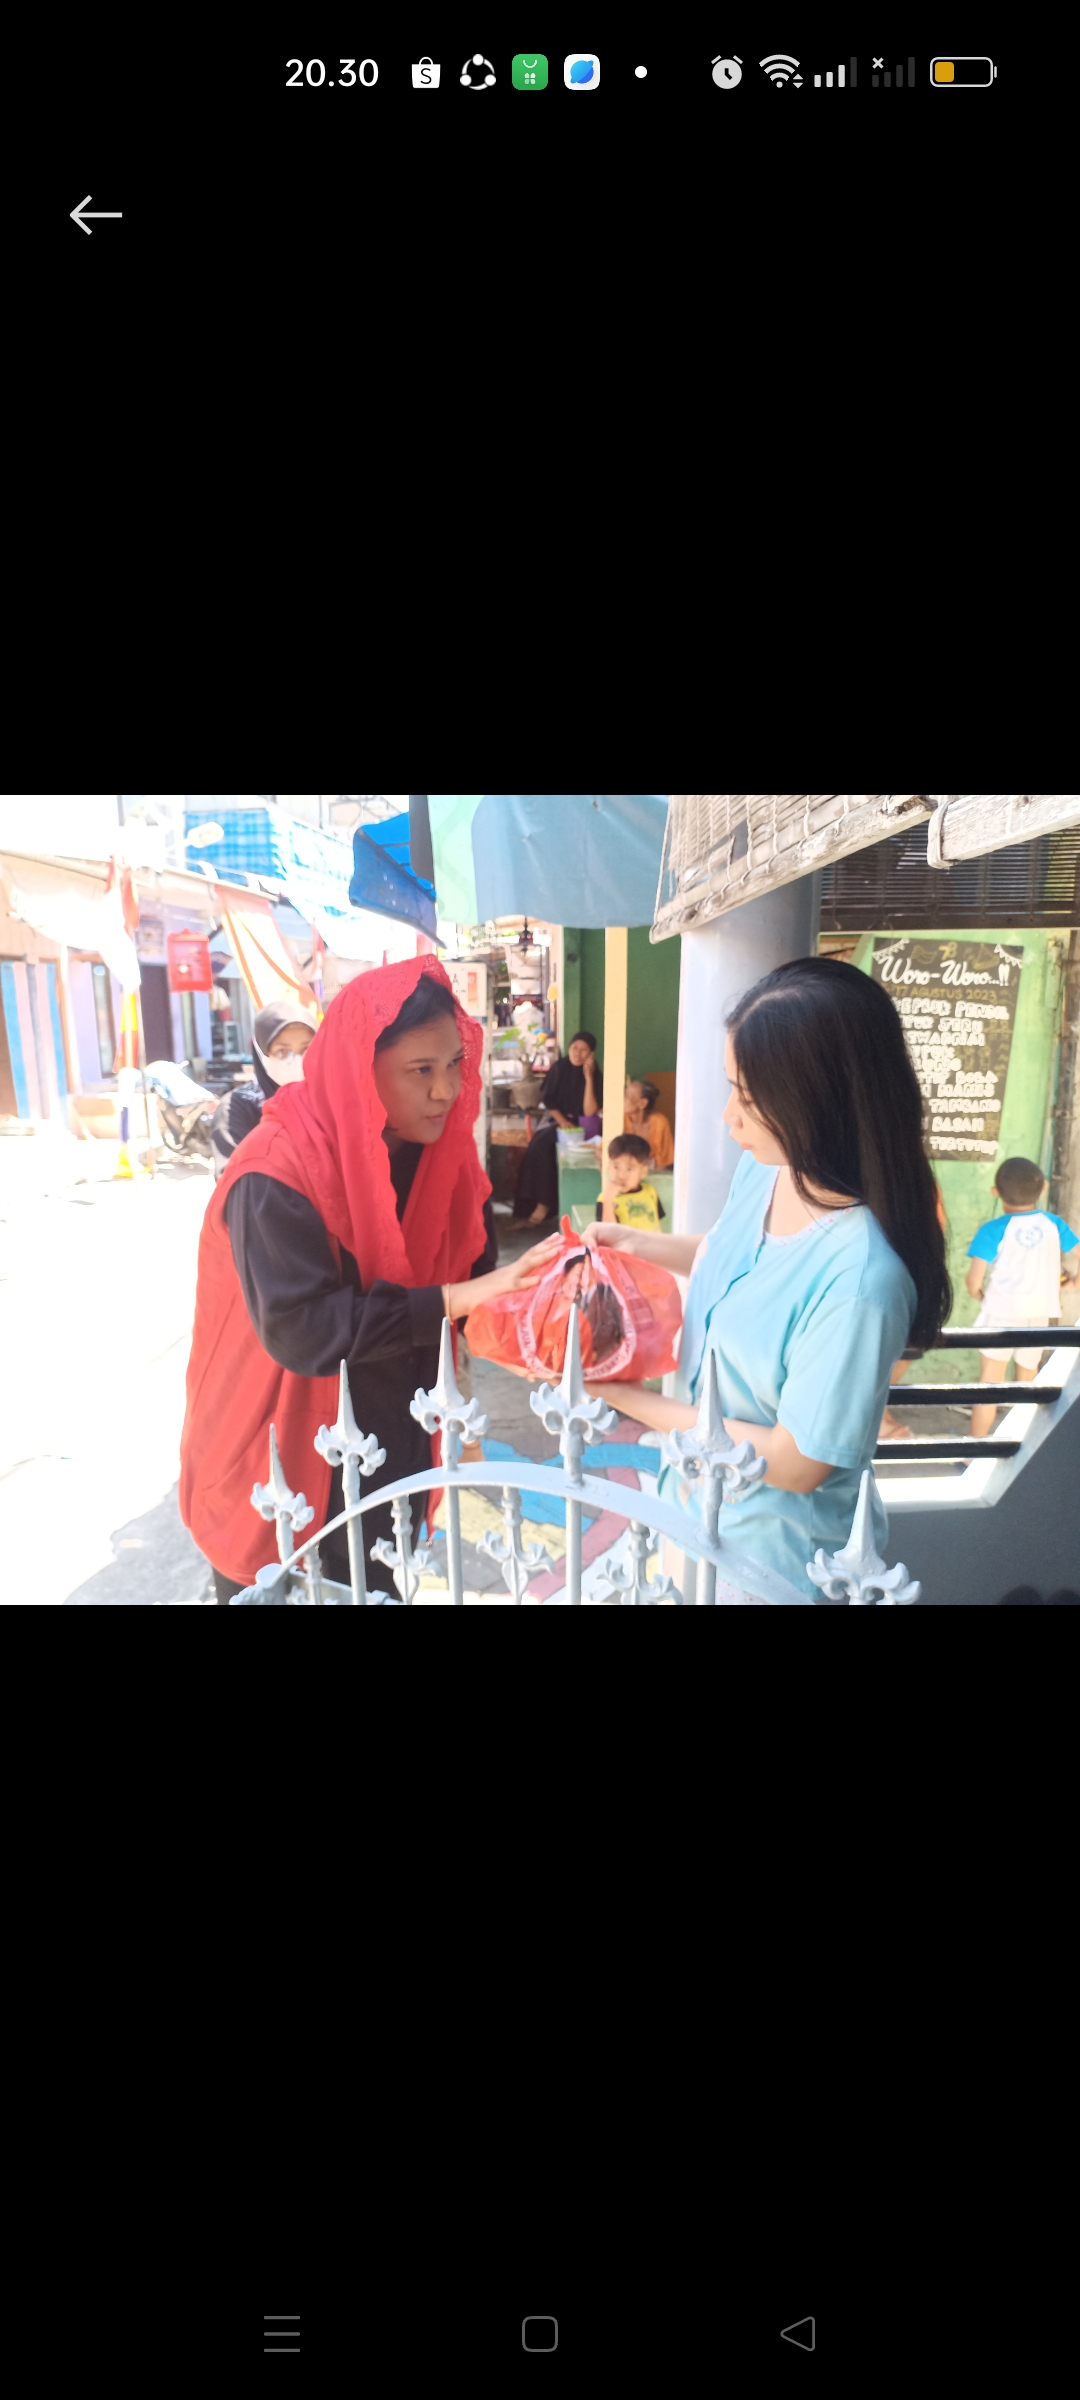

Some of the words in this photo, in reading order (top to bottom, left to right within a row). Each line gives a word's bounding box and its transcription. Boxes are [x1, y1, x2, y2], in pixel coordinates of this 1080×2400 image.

[909, 986, 963, 1000] AGUSTUS
[965, 989, 998, 1001] 2023
[931, 1116, 985, 1132] BASAH
